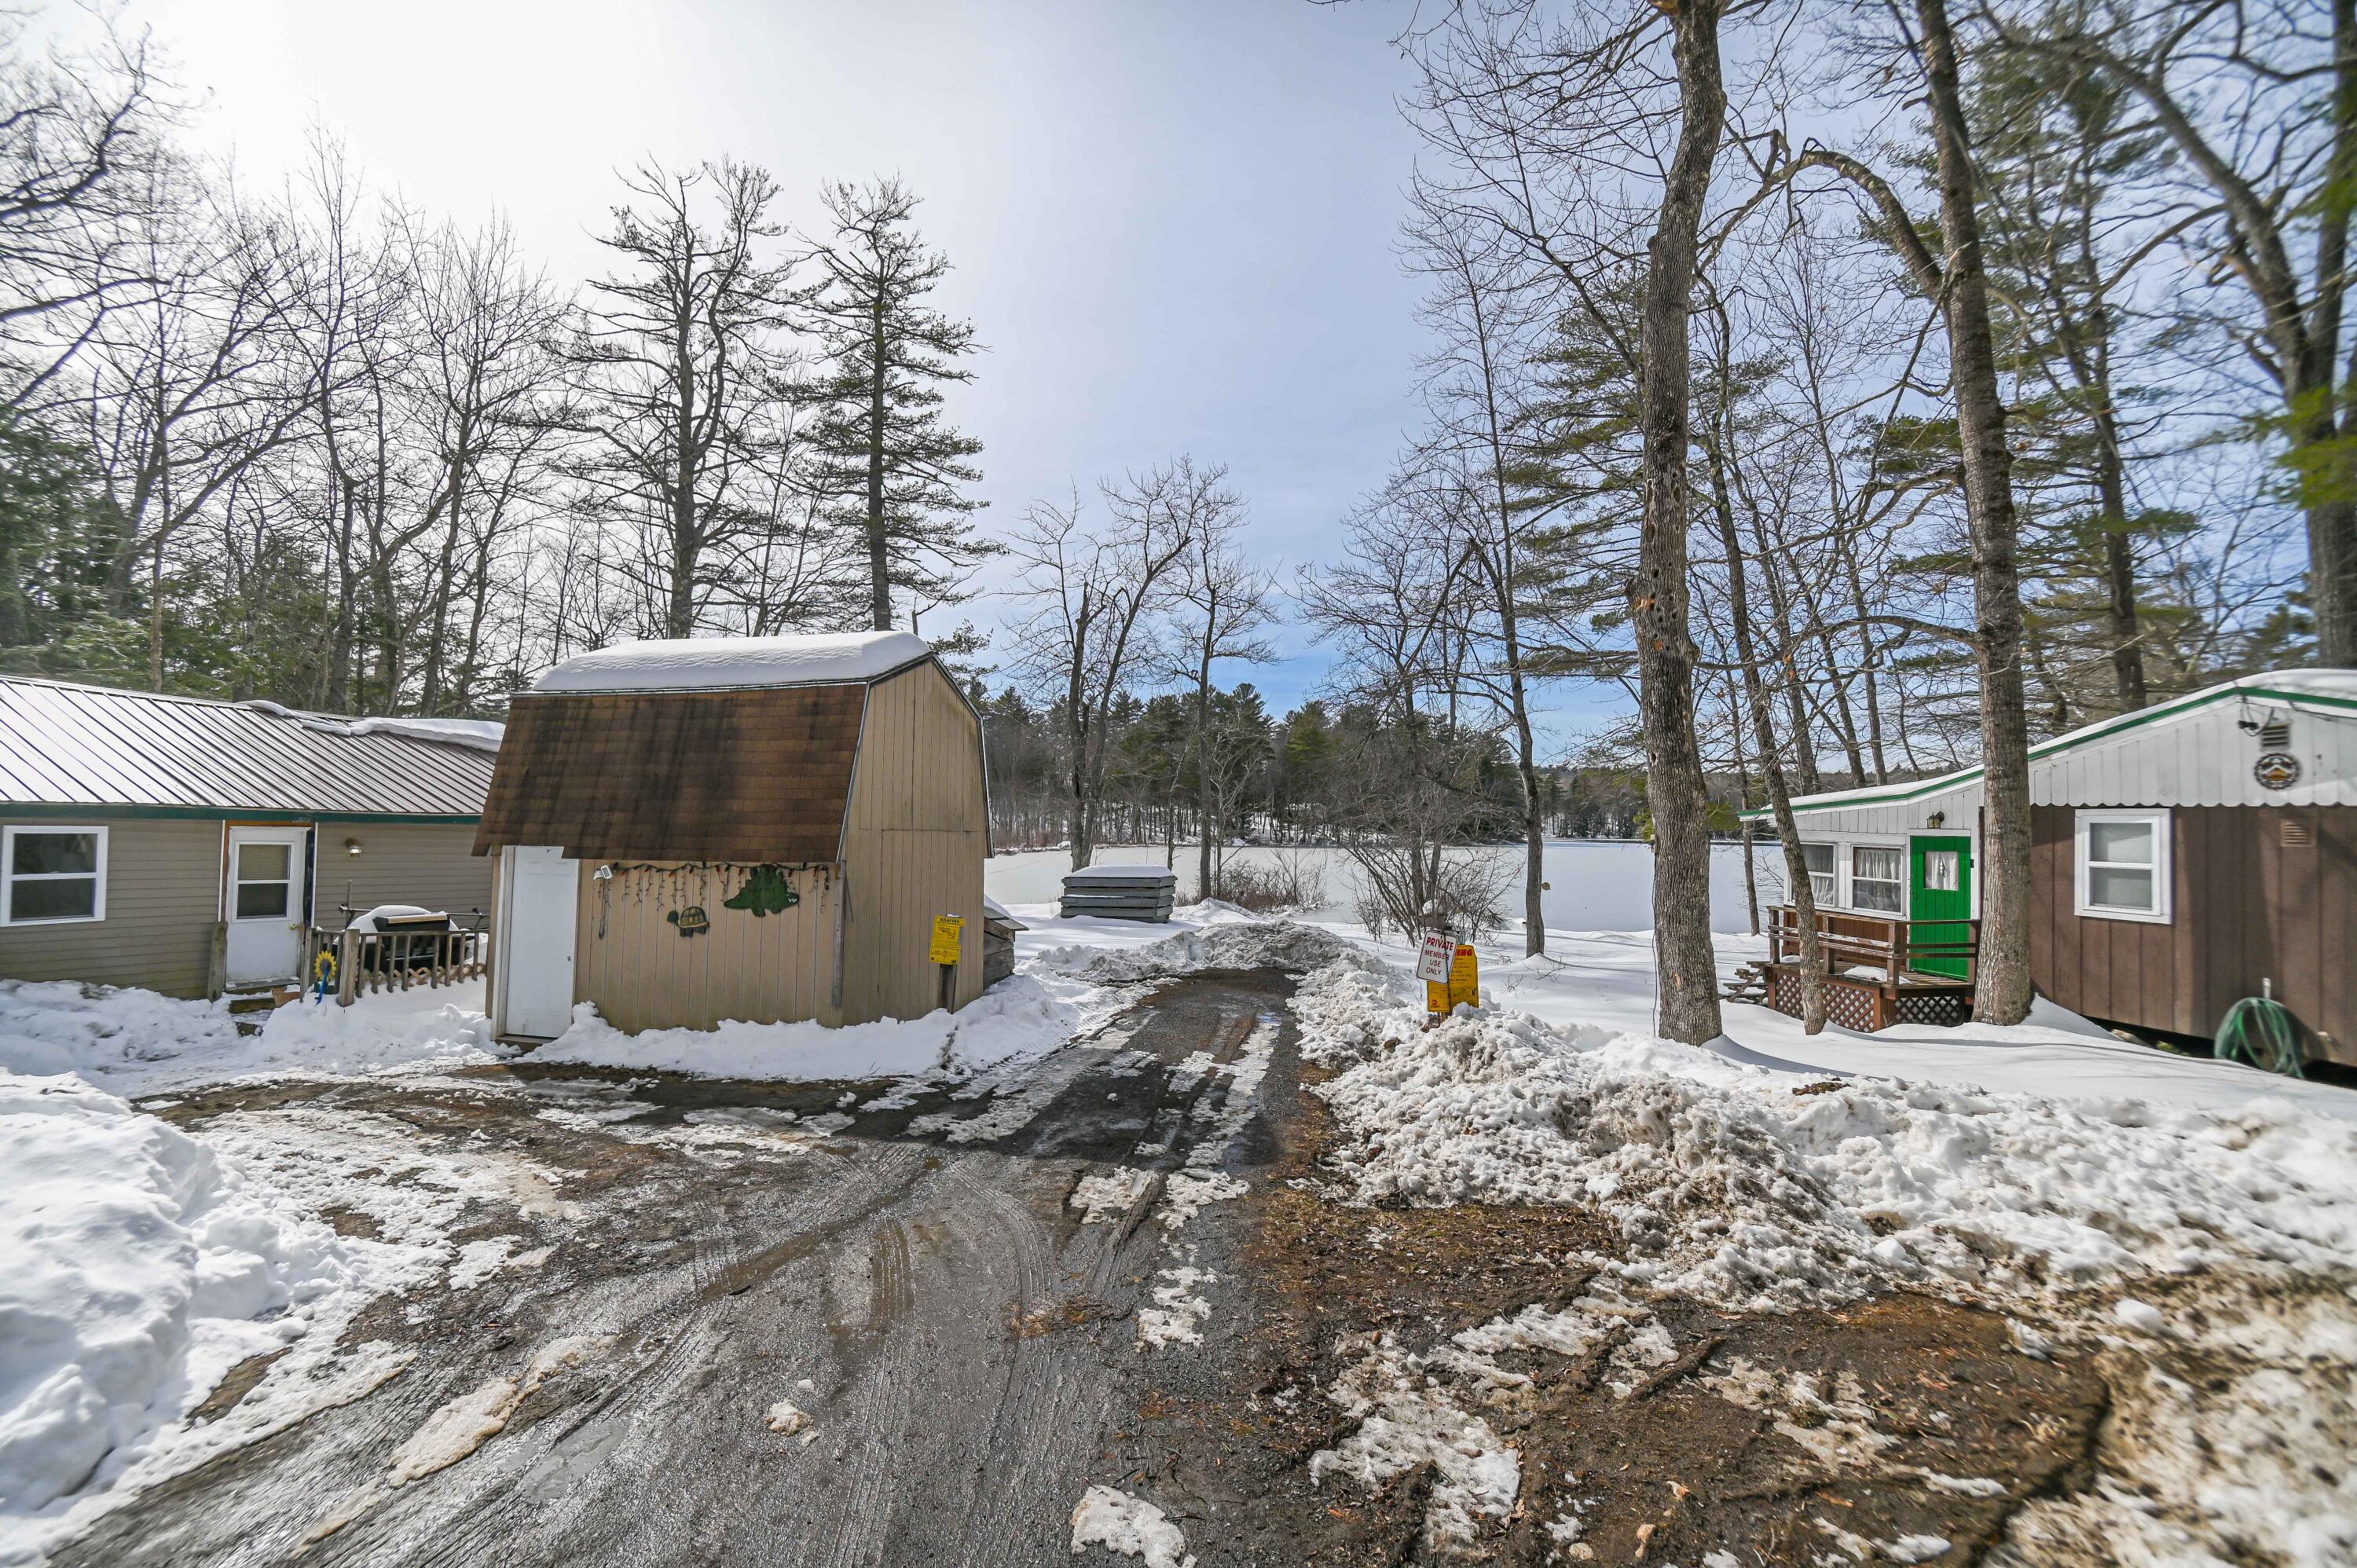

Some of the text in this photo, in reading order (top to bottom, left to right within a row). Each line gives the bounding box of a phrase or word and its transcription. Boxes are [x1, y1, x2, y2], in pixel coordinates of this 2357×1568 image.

[1426, 936, 1453, 951] PRIVATE
[1424, 950, 1450, 960] MEMBER
[1426, 967, 1442, 976] ONLY
